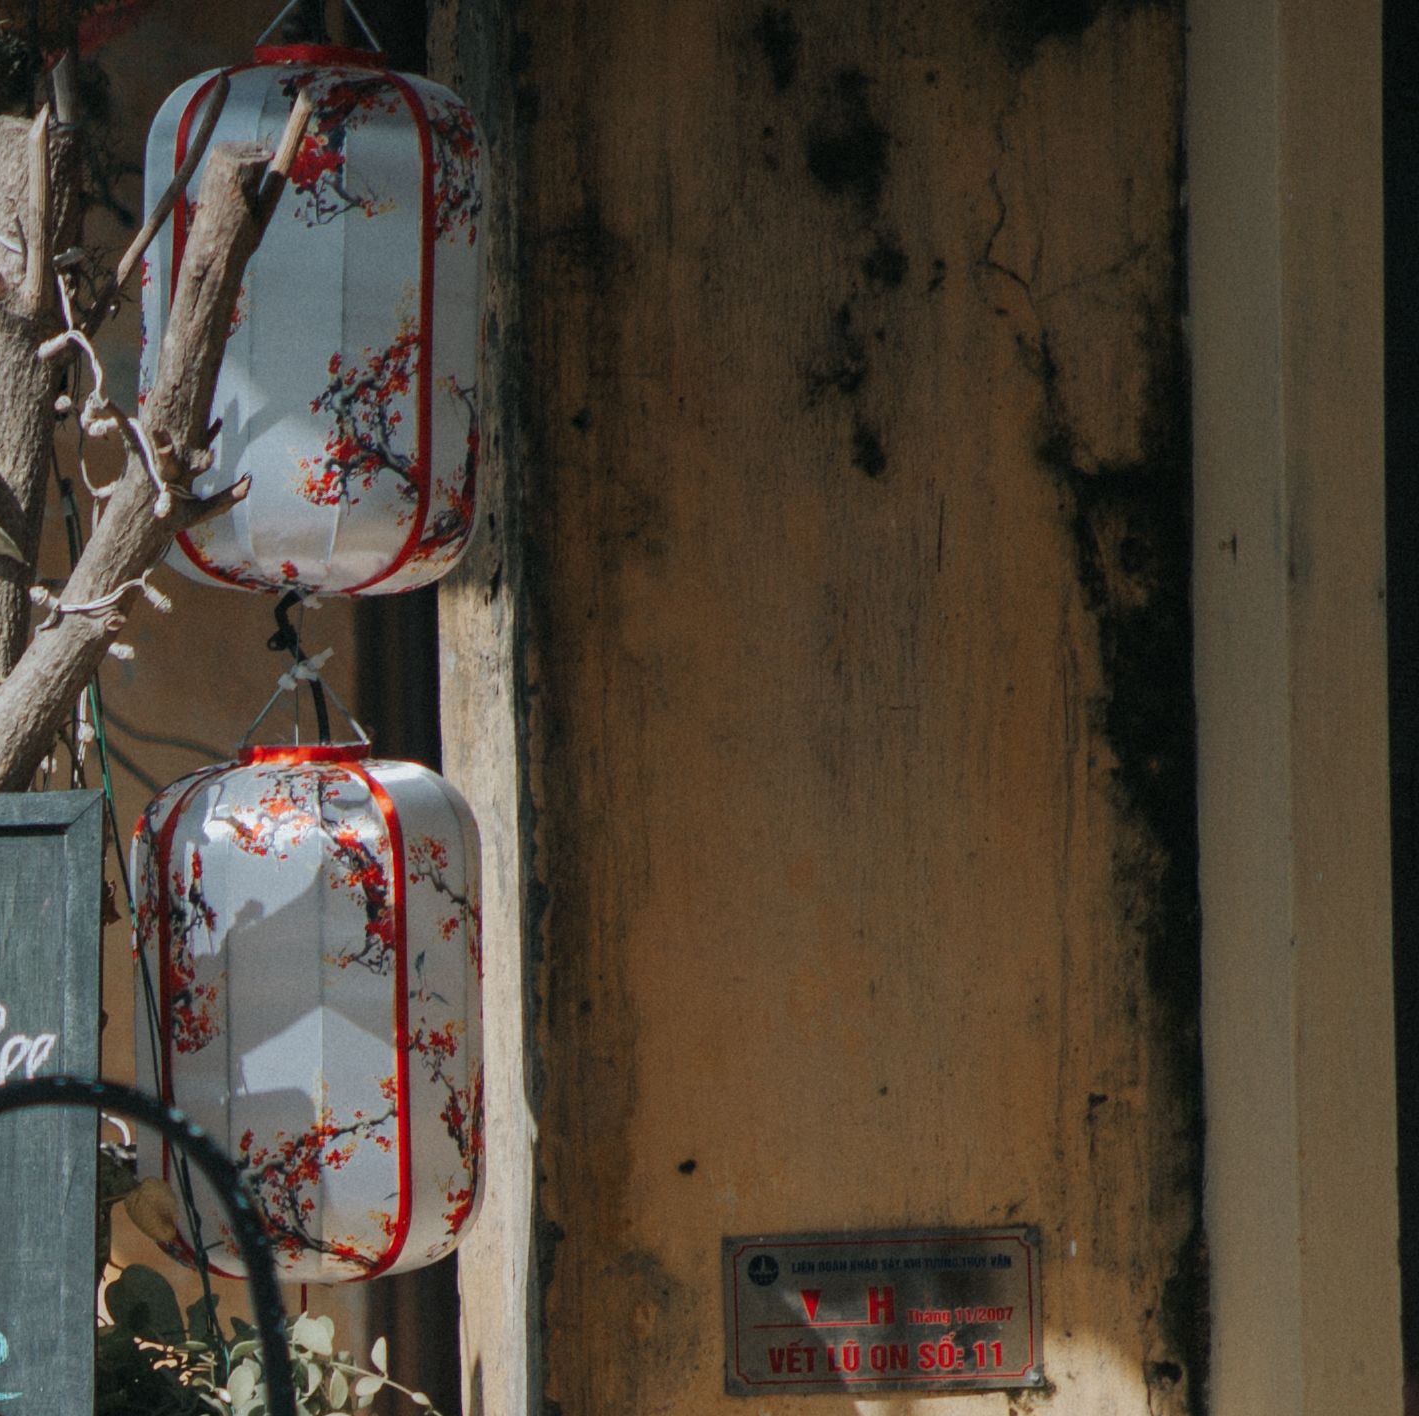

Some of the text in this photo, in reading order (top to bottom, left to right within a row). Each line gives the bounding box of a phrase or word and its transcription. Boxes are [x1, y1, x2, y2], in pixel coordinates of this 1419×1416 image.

[955, 1306, 1013, 1323] 11/2007
[768, 1338, 818, 1373] VẾT
[827, 1338, 860, 1373] LŨ
[869, 1343, 909, 1374] QN
[973, 1341, 1004, 1369] 11
